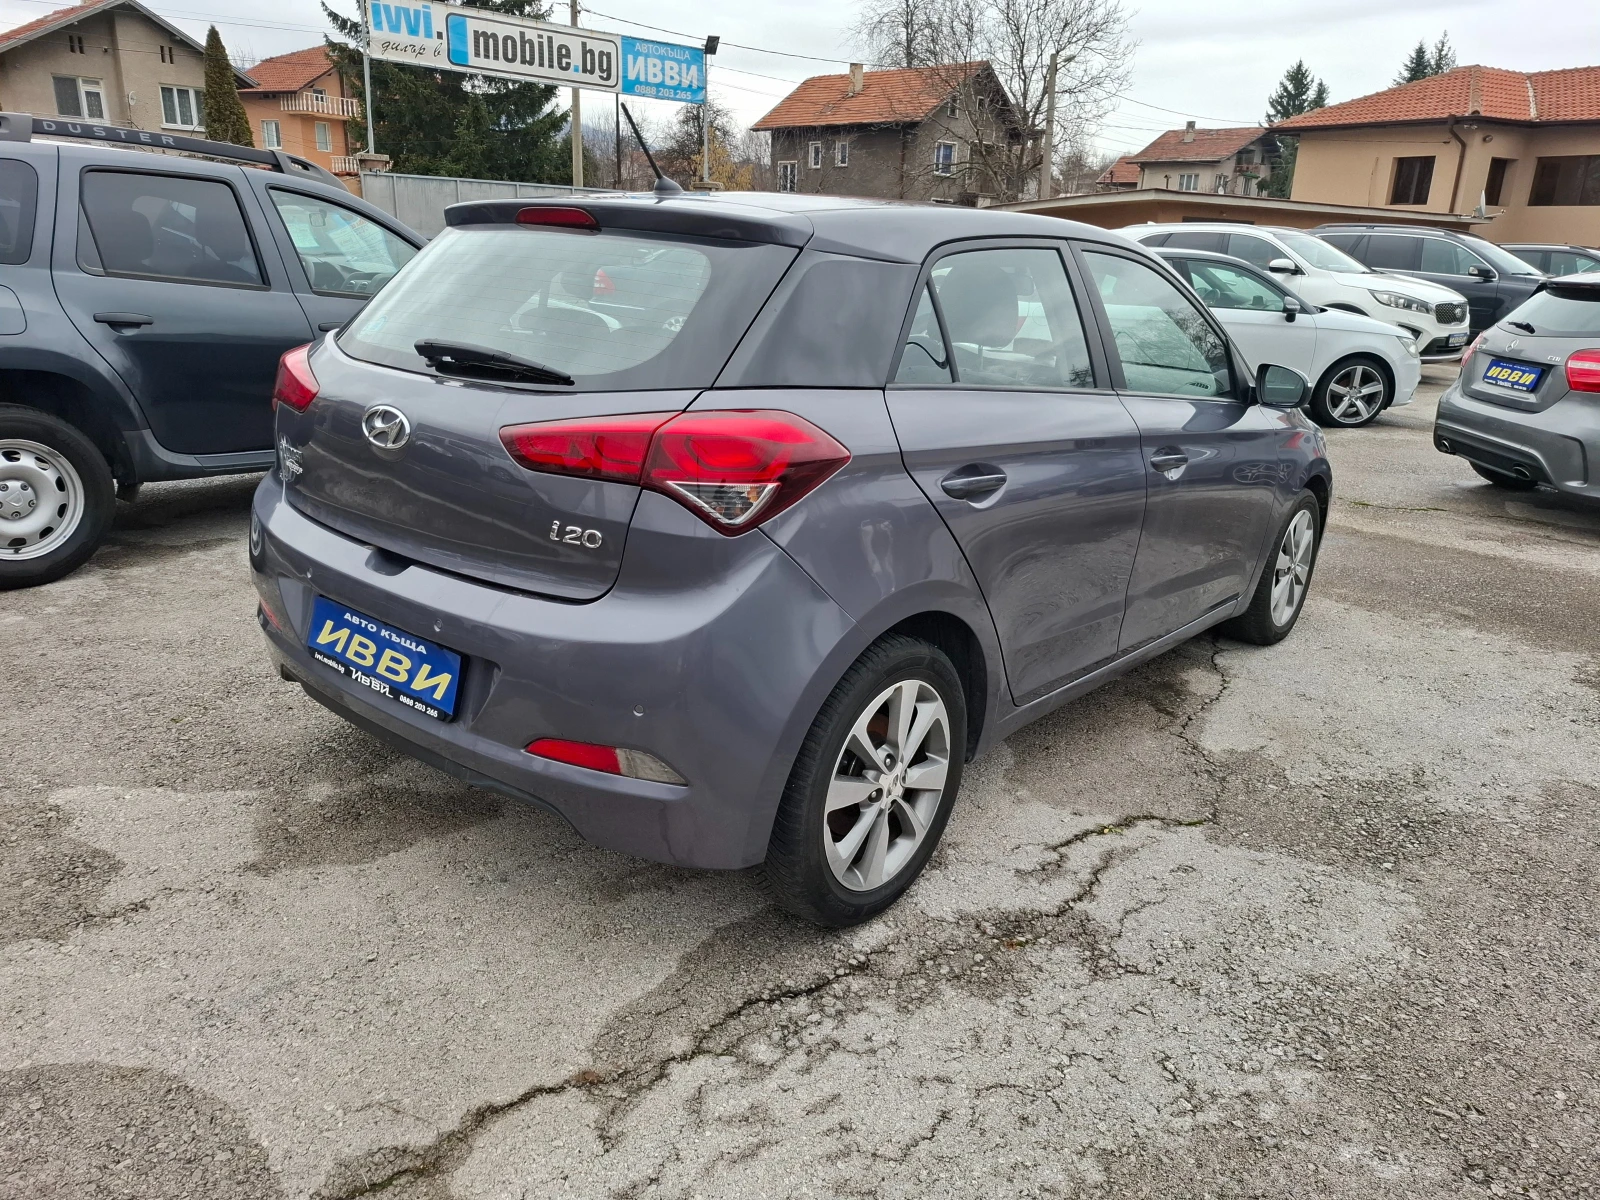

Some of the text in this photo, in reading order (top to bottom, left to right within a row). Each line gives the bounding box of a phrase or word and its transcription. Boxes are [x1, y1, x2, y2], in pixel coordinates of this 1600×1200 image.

[473, 29, 612, 82] mobile.bg
[634, 43, 691, 61] АВТОКЪЩА
[627, 54, 698, 89] ИВВИ
[634, 84, 692, 100] 0888 203 265
[43, 121, 175, 146] DUSTER
[1487, 366, 1536, 385] ИВВИ
[549, 520, 603, 549] i20
[344, 612, 427, 655] АВТО КЪЩА
[316, 619, 452, 701] ИВВИ
[414, 701, 426, 712] 203
[426, 707, 438, 717] 265
